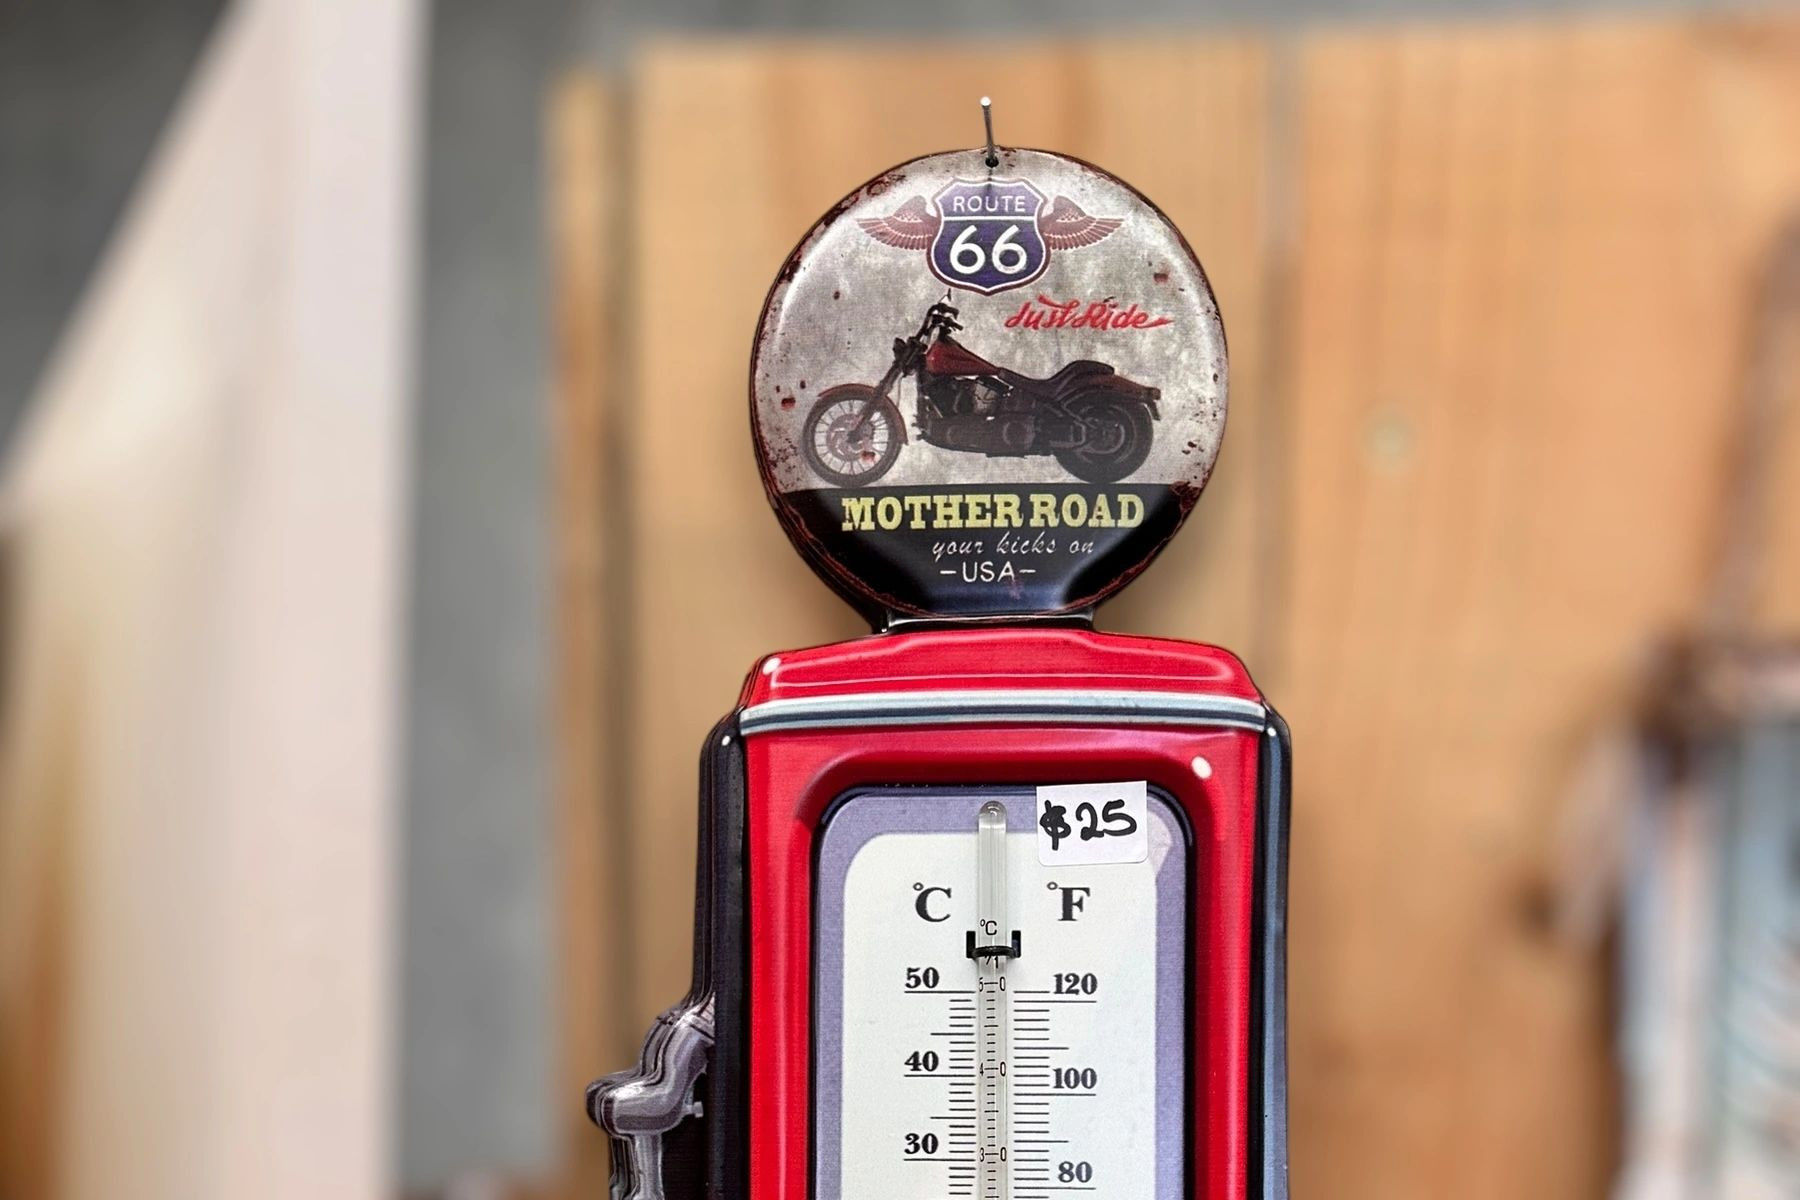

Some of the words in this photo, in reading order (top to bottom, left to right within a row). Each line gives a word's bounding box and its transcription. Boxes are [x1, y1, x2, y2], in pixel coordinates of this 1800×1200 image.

[952, 195, 1027, 213] ROUTE
[949, 224, 1028, 274] 66
[1004, 294, 1080, 330] Just
[1071, 296, 1175, 331] Ride
[841, 494, 1025, 532] MOTHER
[1030, 493, 1145, 529] ROAD
[932, 538, 984, 562] your
[996, 531, 1057, 555] kicks
[1069, 540, 1095, 555] on
[1040, 799, 1137, 850] $25
[906, 967, 939, 988] 50
[1054, 974, 1097, 994] 120
[905, 1051, 938, 1071] 40
[1054, 1068, 1096, 1089] 100
[905, 1133, 938, 1154] 30
[1059, 1162, 1091, 1182] 80
